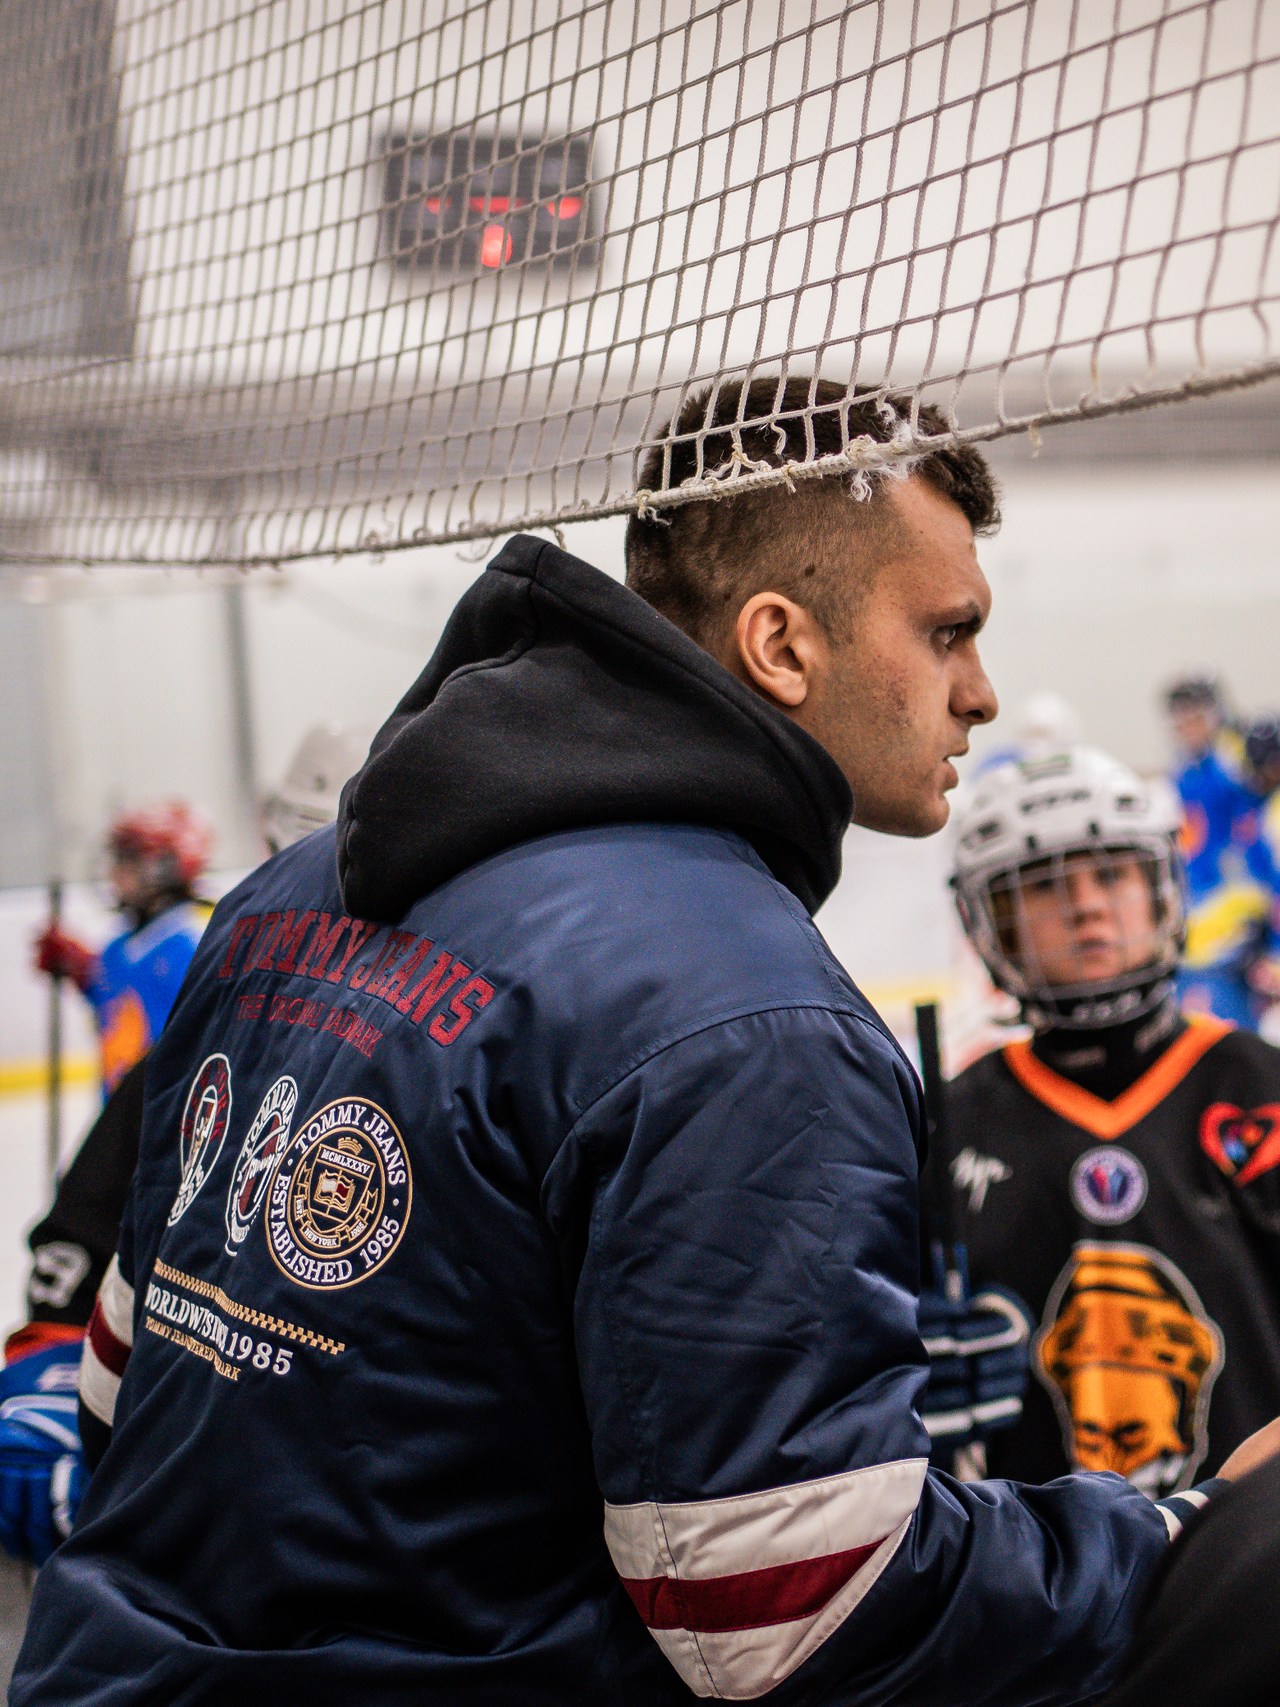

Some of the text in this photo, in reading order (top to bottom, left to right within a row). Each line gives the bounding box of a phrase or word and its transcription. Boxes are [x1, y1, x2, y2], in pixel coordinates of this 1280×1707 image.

[217, 908, 498, 1049] TOMMY JEANS
[294, 1104, 407, 1186] TOMMY JEANS
[321, 1149, 370, 1175] MCMLXXXV
[271, 1172, 353, 1283] ESTABLISHED
[359, 1215, 399, 1269] 1985
[225, 1331, 294, 1376] 1985
